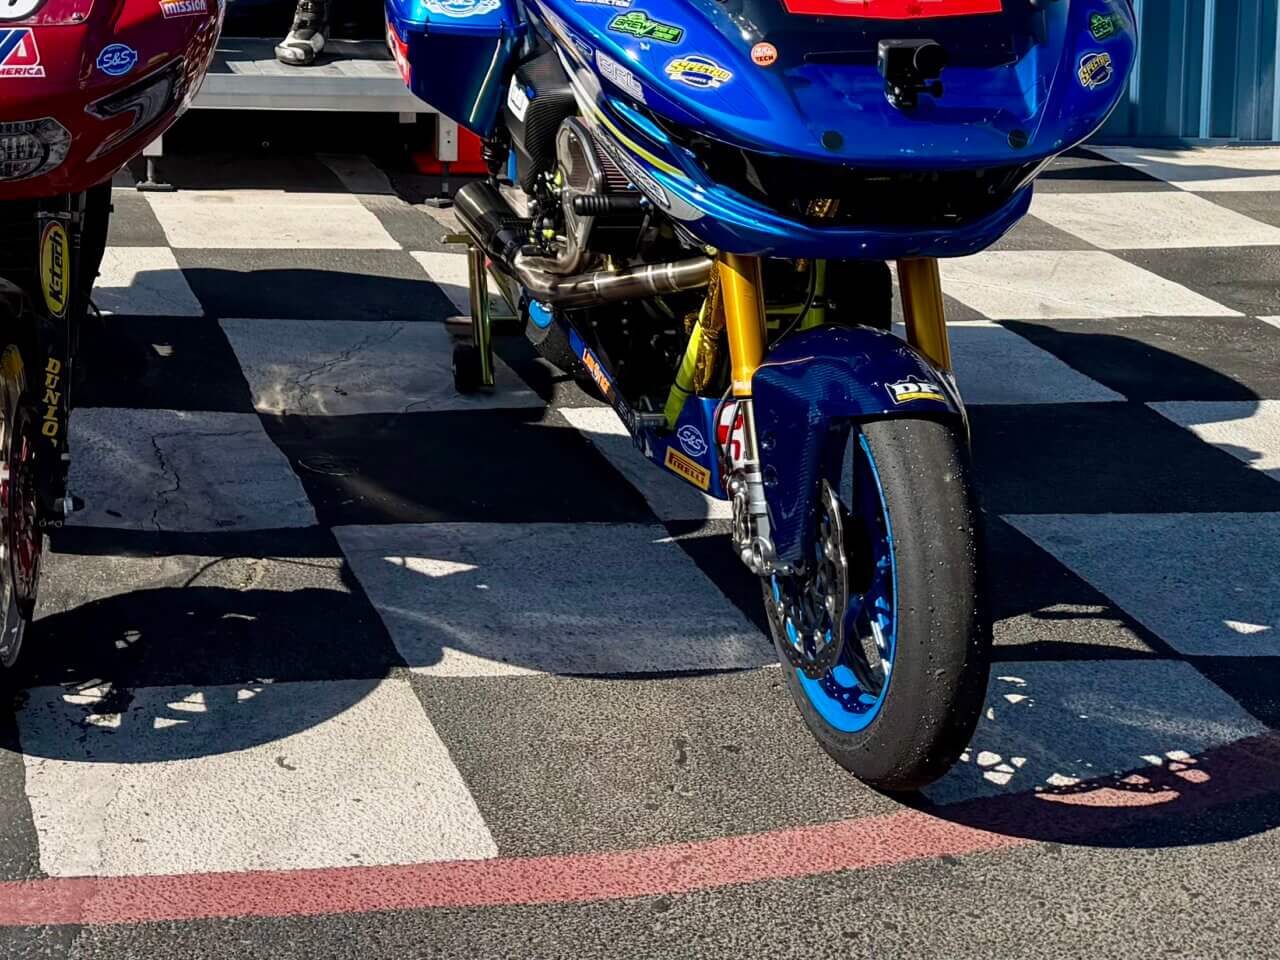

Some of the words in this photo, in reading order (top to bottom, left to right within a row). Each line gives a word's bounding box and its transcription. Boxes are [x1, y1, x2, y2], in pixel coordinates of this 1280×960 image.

[103, 52, 131, 66] S&S
[755, 54, 774, 62] TECH
[668, 59, 731, 82] SPECTRO
[41, 357, 62, 448] DUNLO
[679, 429, 703, 450] S&S
[668, 453, 705, 485] PIRELLI
